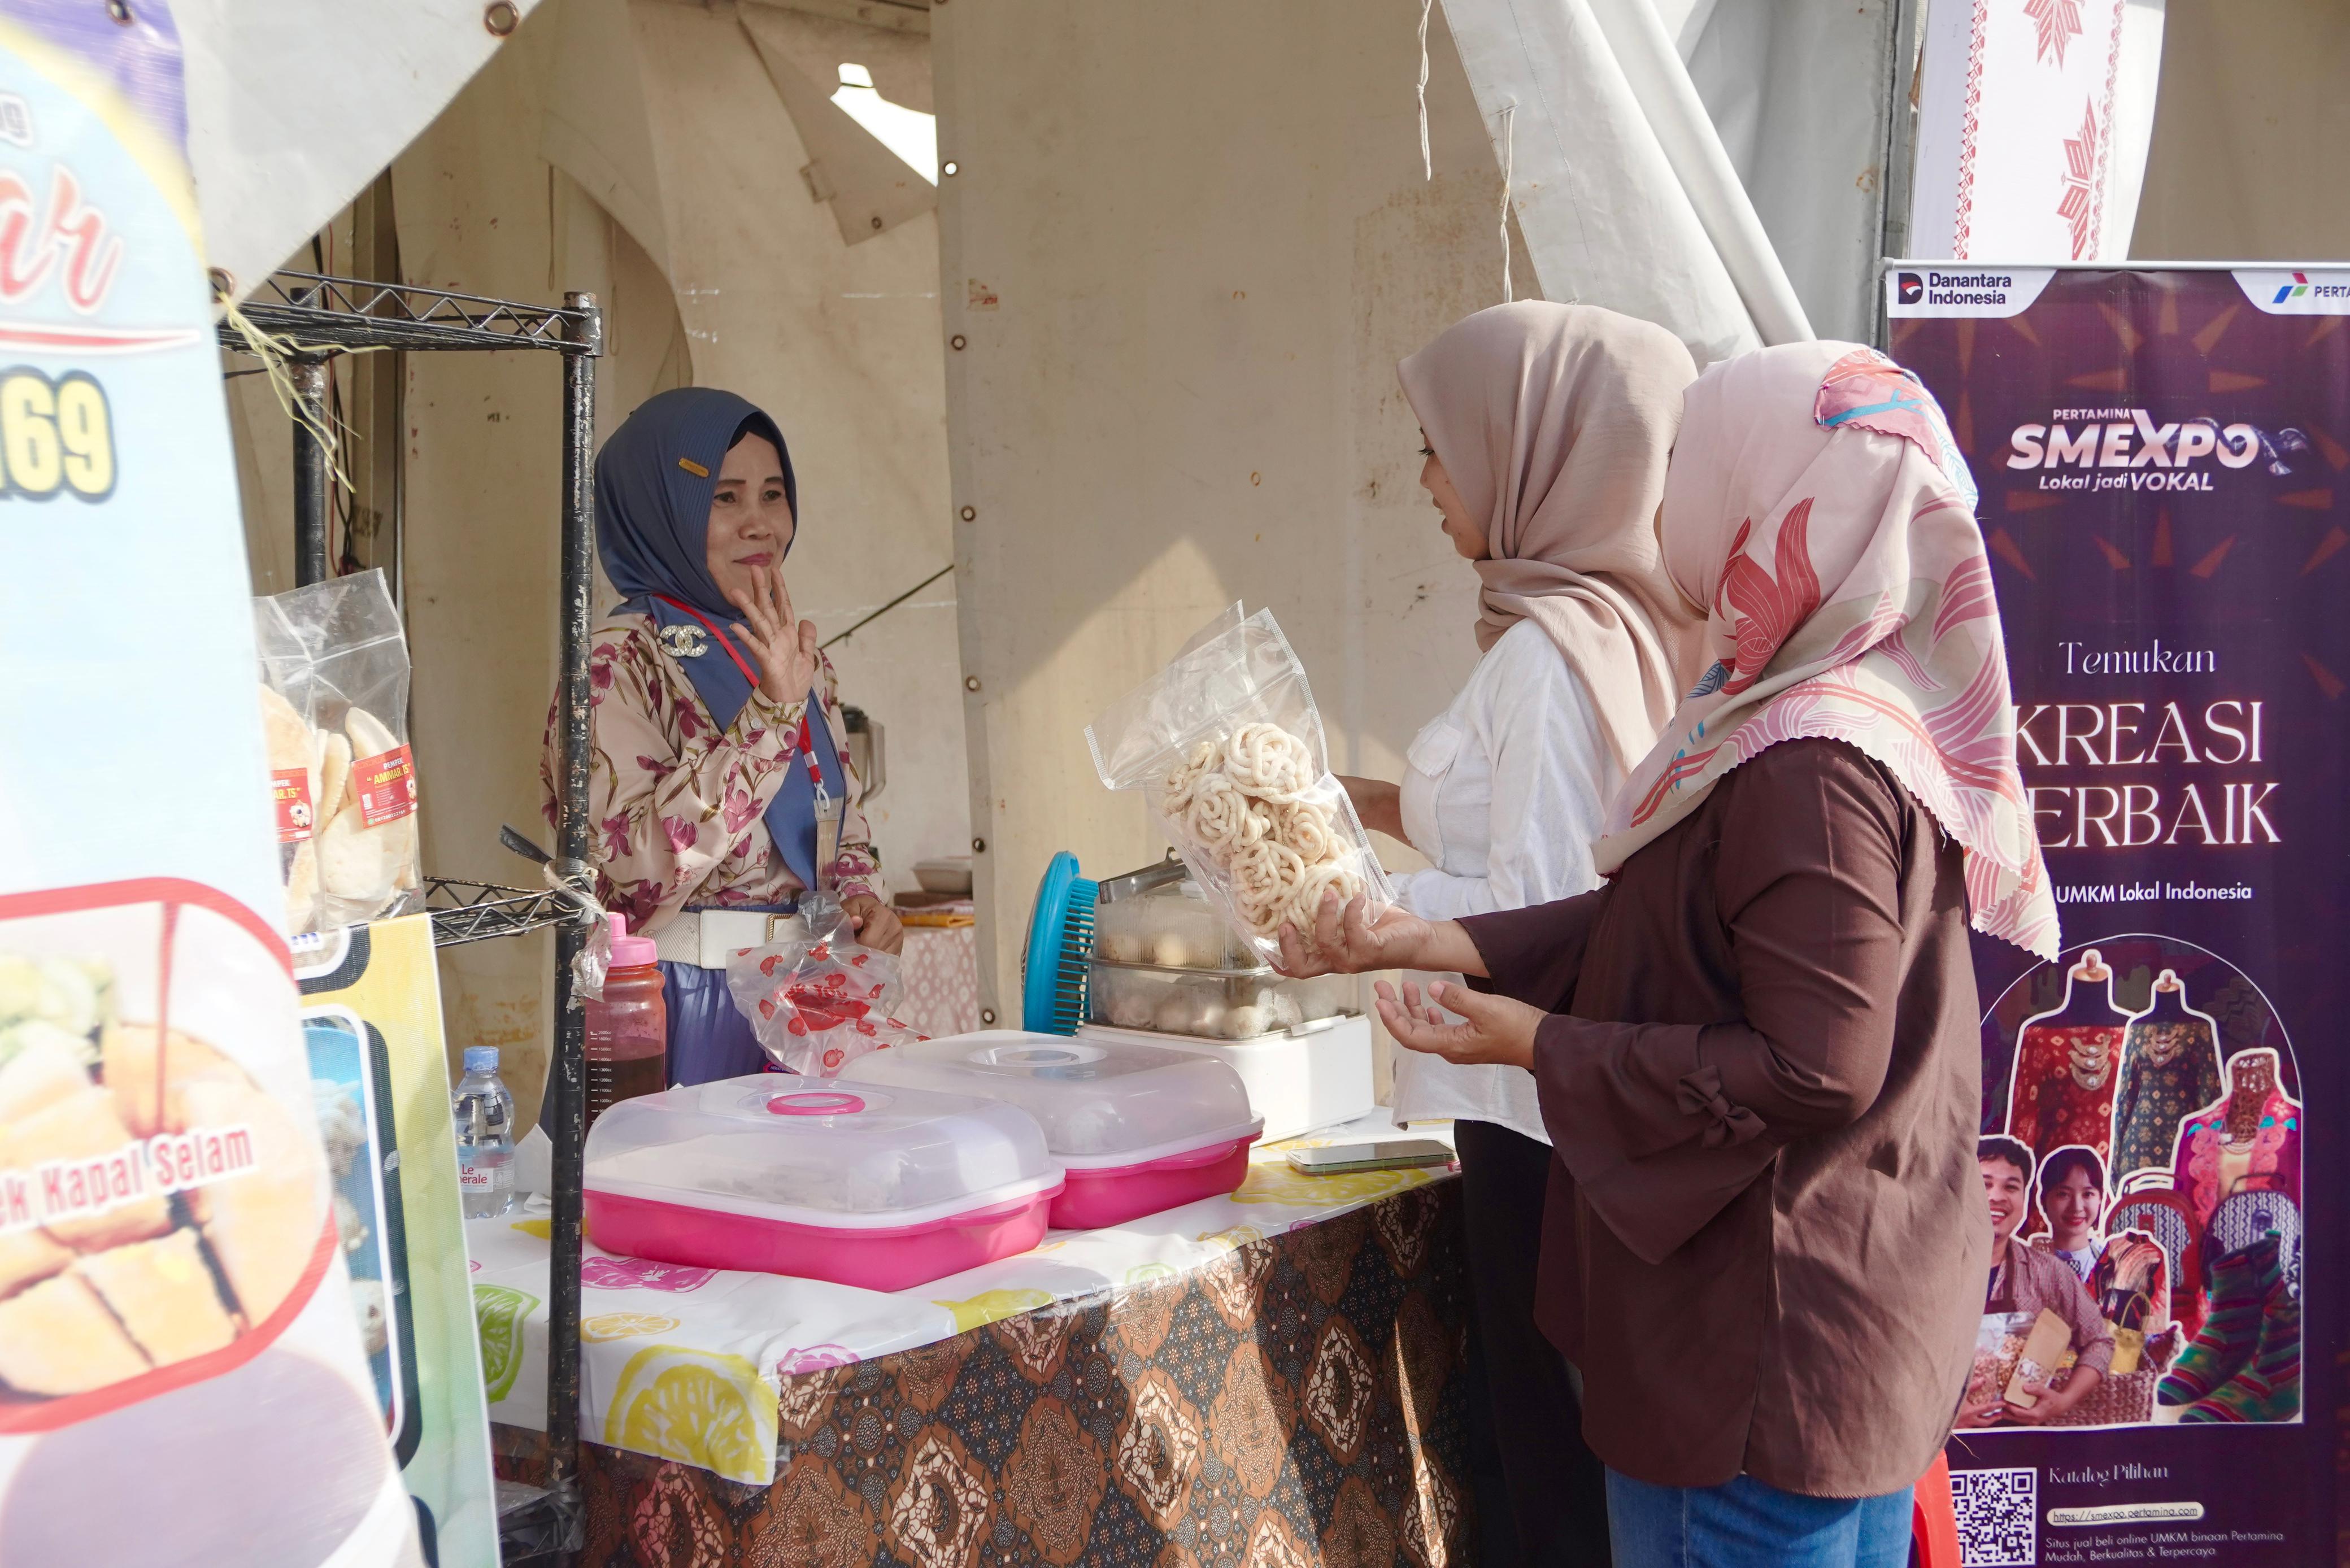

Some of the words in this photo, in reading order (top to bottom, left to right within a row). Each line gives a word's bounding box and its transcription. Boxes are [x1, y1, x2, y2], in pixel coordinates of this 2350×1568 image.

[1929, 273, 2012, 288] Danantara
[1929, 290, 2006, 304] Indonesia
[2053, 408, 2130, 420] PERTAMINA
[0, 366, 118, 503] 69
[2006, 409, 2259, 469] SMEXPO
[2039, 475, 2090, 490] Lokal
[2092, 473, 2128, 492] jadi
[2130, 472, 2214, 492] VOKAL
[2059, 639, 2217, 674] Temukan
[2012, 701, 2264, 766] KREASI
[383, 757, 403, 770] PEMPEK
[2056, 885, 2115, 903] UMKM
[2120, 881, 2160, 901] Lokal
[2166, 881, 2252, 900] Indonesia
[41, 1149, 143, 1214] Kapal
[155, 1129, 254, 1186] Selam
[462, 1164, 474, 1175] Le
[2049, 1466, 2109, 1487] Katalog
[2114, 1463, 2169, 1480] Pilihan
[2053, 1506, 2198, 1523] https://smexpo.pertamina.com
[2046, 1537, 2070, 1548] Situs
[2073, 1536, 2092, 1550] jual
[2095, 1534, 2114, 1546] beli
[2117, 1534, 2147, 1545] online
[2151, 1532, 2188, 1543] UMKM
[2191, 1531, 2228, 1542] binaan
[2231, 1530, 2284, 1541] Pertamina
[2090, 1548, 2144, 1561] Berkualitas
[2147, 1547, 2156, 1557] &
[2159, 1546, 2216, 1559] Terpercaya
